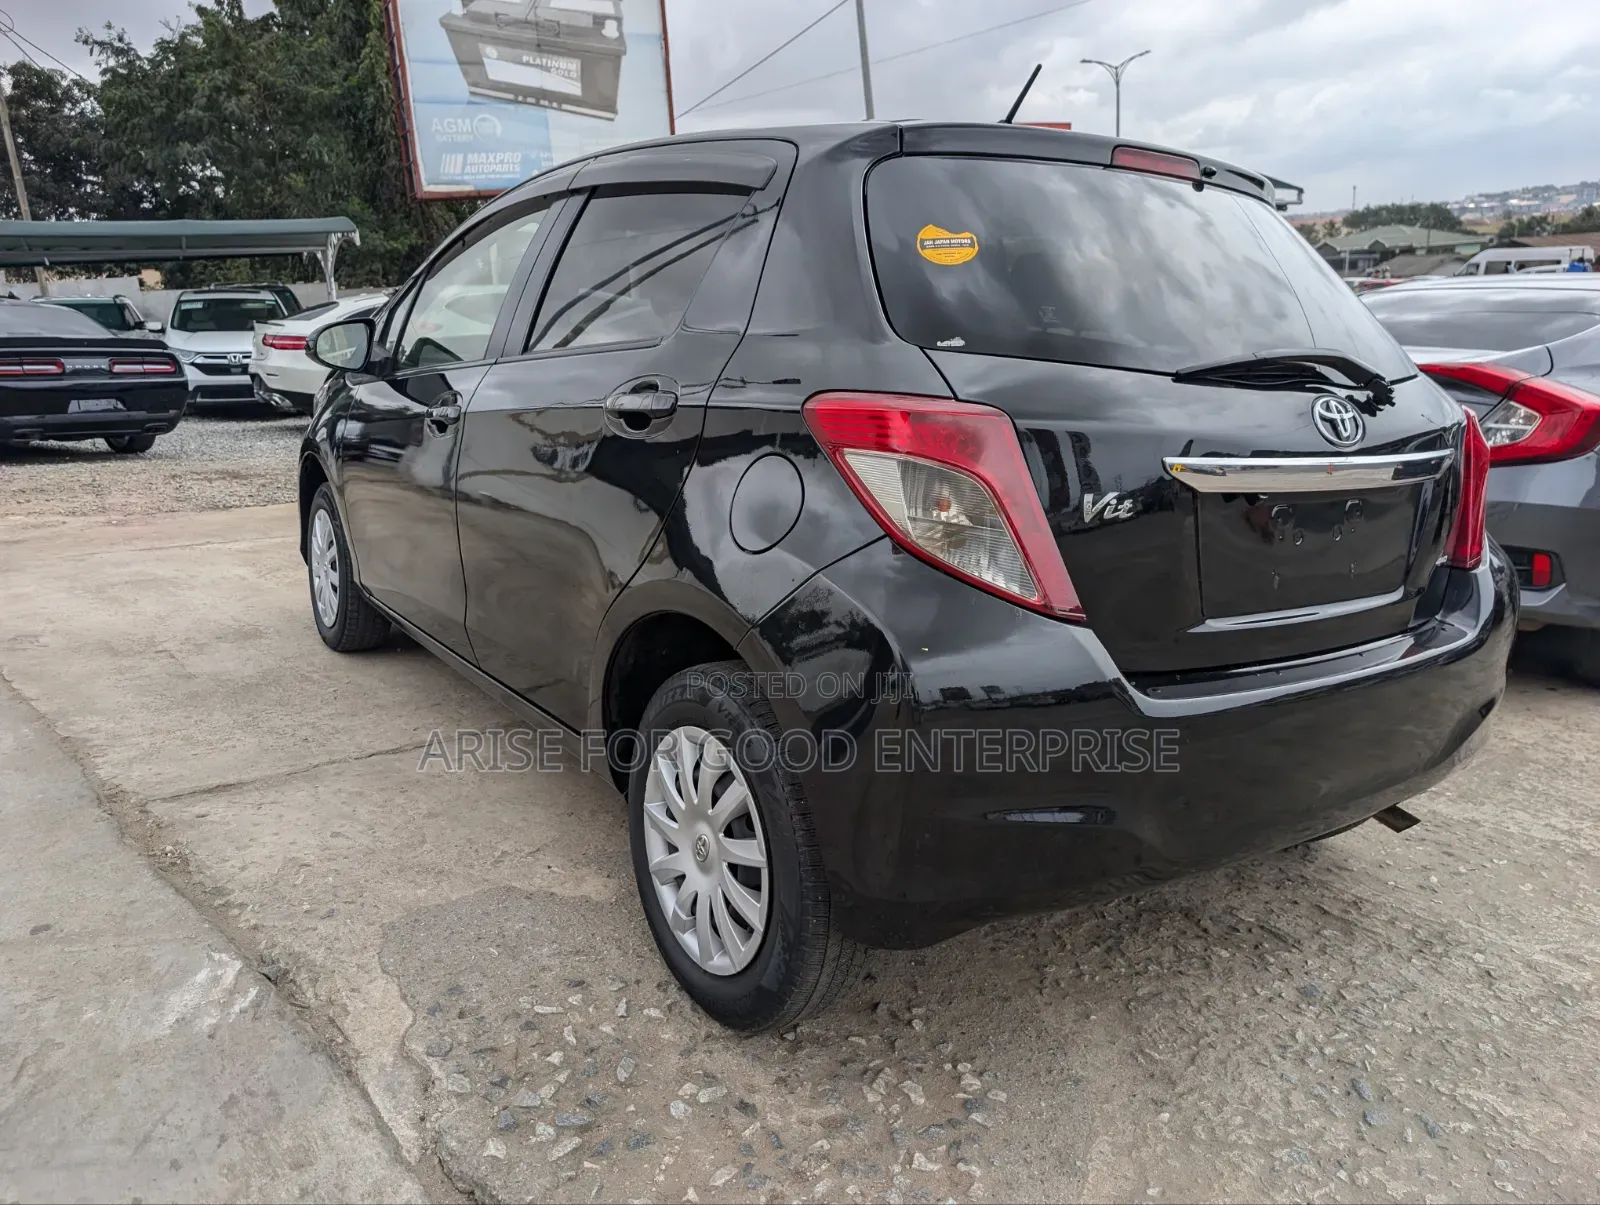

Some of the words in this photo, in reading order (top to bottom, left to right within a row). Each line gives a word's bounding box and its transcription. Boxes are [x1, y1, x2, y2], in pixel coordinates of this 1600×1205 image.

[522, 54, 577, 71] PLATINUM
[550, 67, 577, 78] GOLD
[431, 118, 472, 133] AGM
[435, 133, 474, 142] BATTERY
[466, 152, 522, 164] MAXPRO
[463, 163, 521, 174] AUTOPARTS
